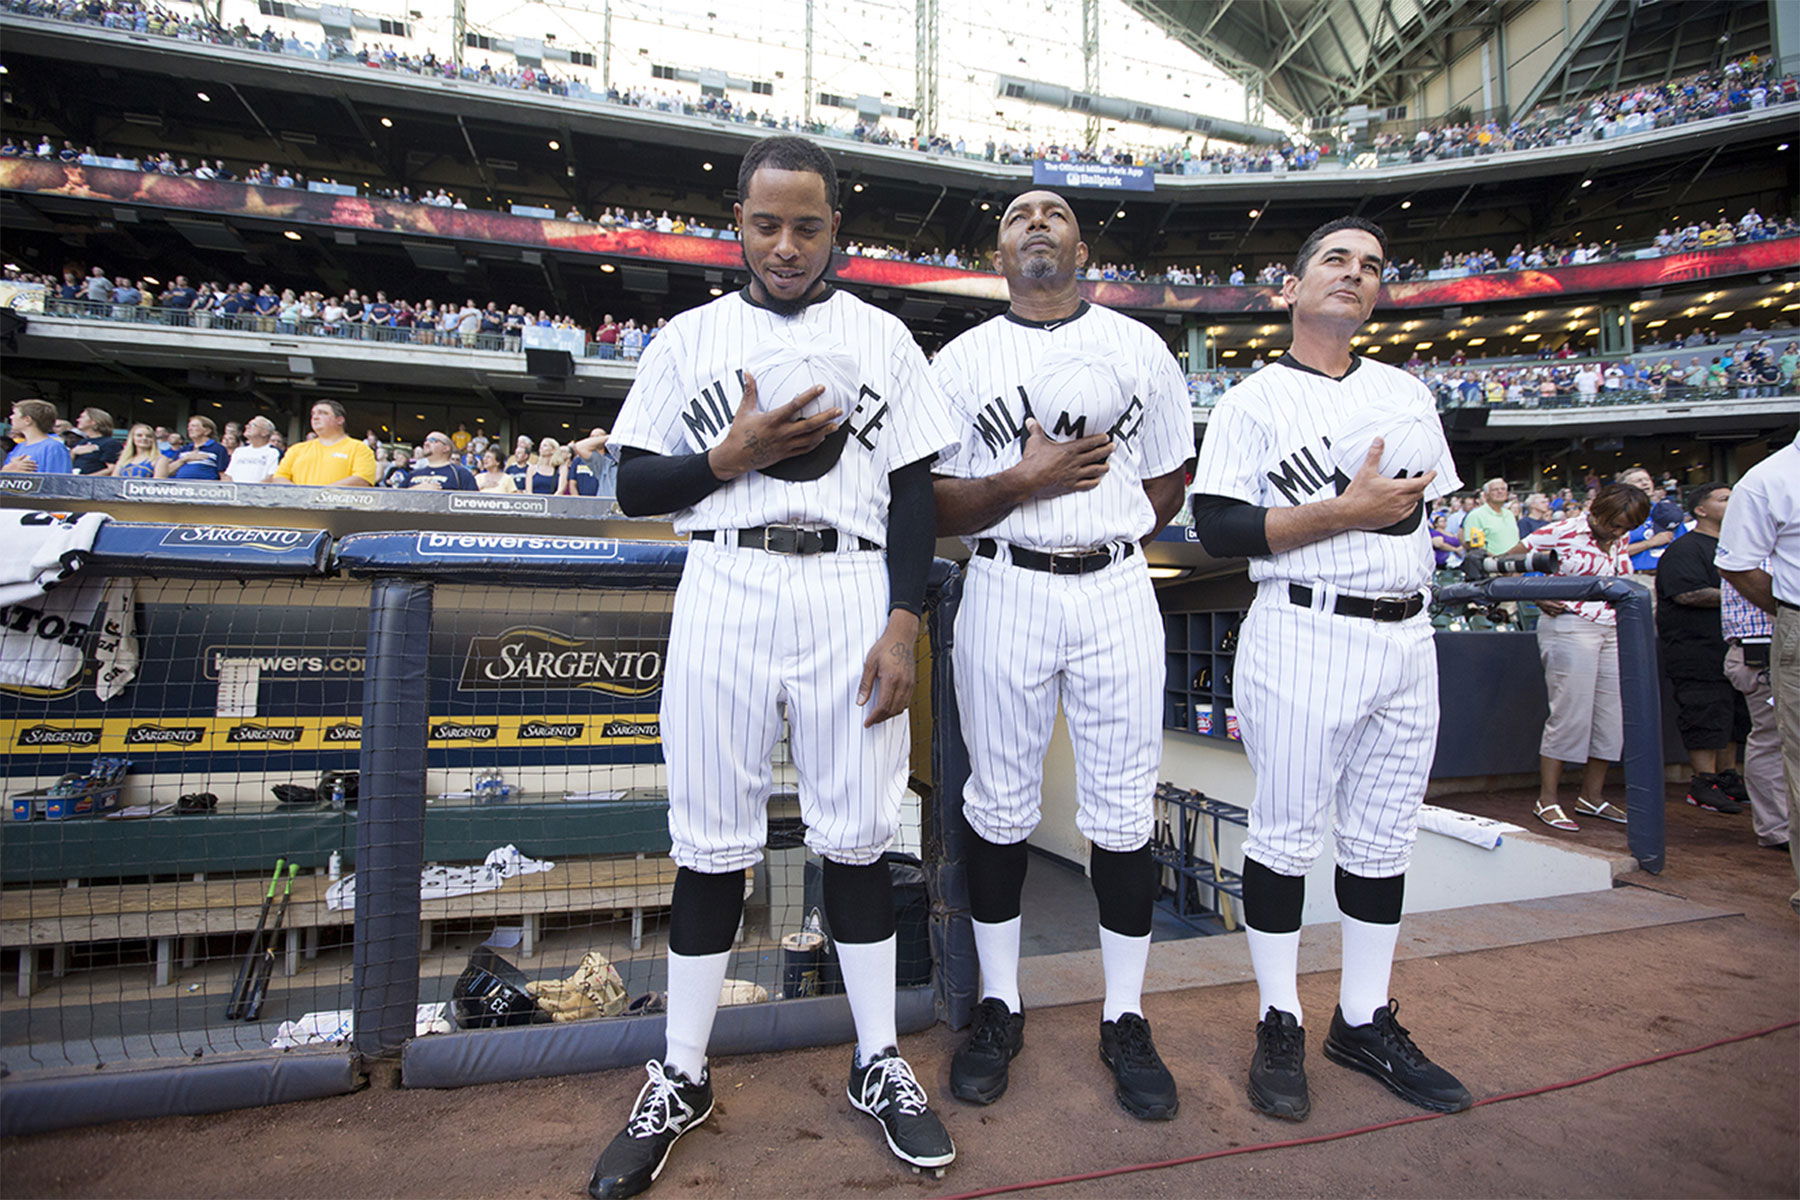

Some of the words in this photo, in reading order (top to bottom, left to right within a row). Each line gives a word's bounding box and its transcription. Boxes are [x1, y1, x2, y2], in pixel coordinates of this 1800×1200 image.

[1108, 166, 1126, 176] Park
[1127, 168, 1144, 177] App
[1081, 174, 1122, 187] Ballpark
[129, 482, 232, 498] brewers.com
[315, 491, 374, 505] SARGENTO
[453, 497, 544, 512] brewers.com
[180, 526, 301, 544] SARGENTO
[428, 532, 609, 551] brewers.com
[484, 642, 662, 681] SARGENTO
[132, 729, 197, 743] SARGENTO
[233, 727, 295, 740] SARGENTO
[435, 725, 491, 739] SARGENTO
[523, 725, 577, 738] SARGENTO
[606, 722, 658, 737] SARGENTO
[25, 730, 94, 744] SARGENTO
